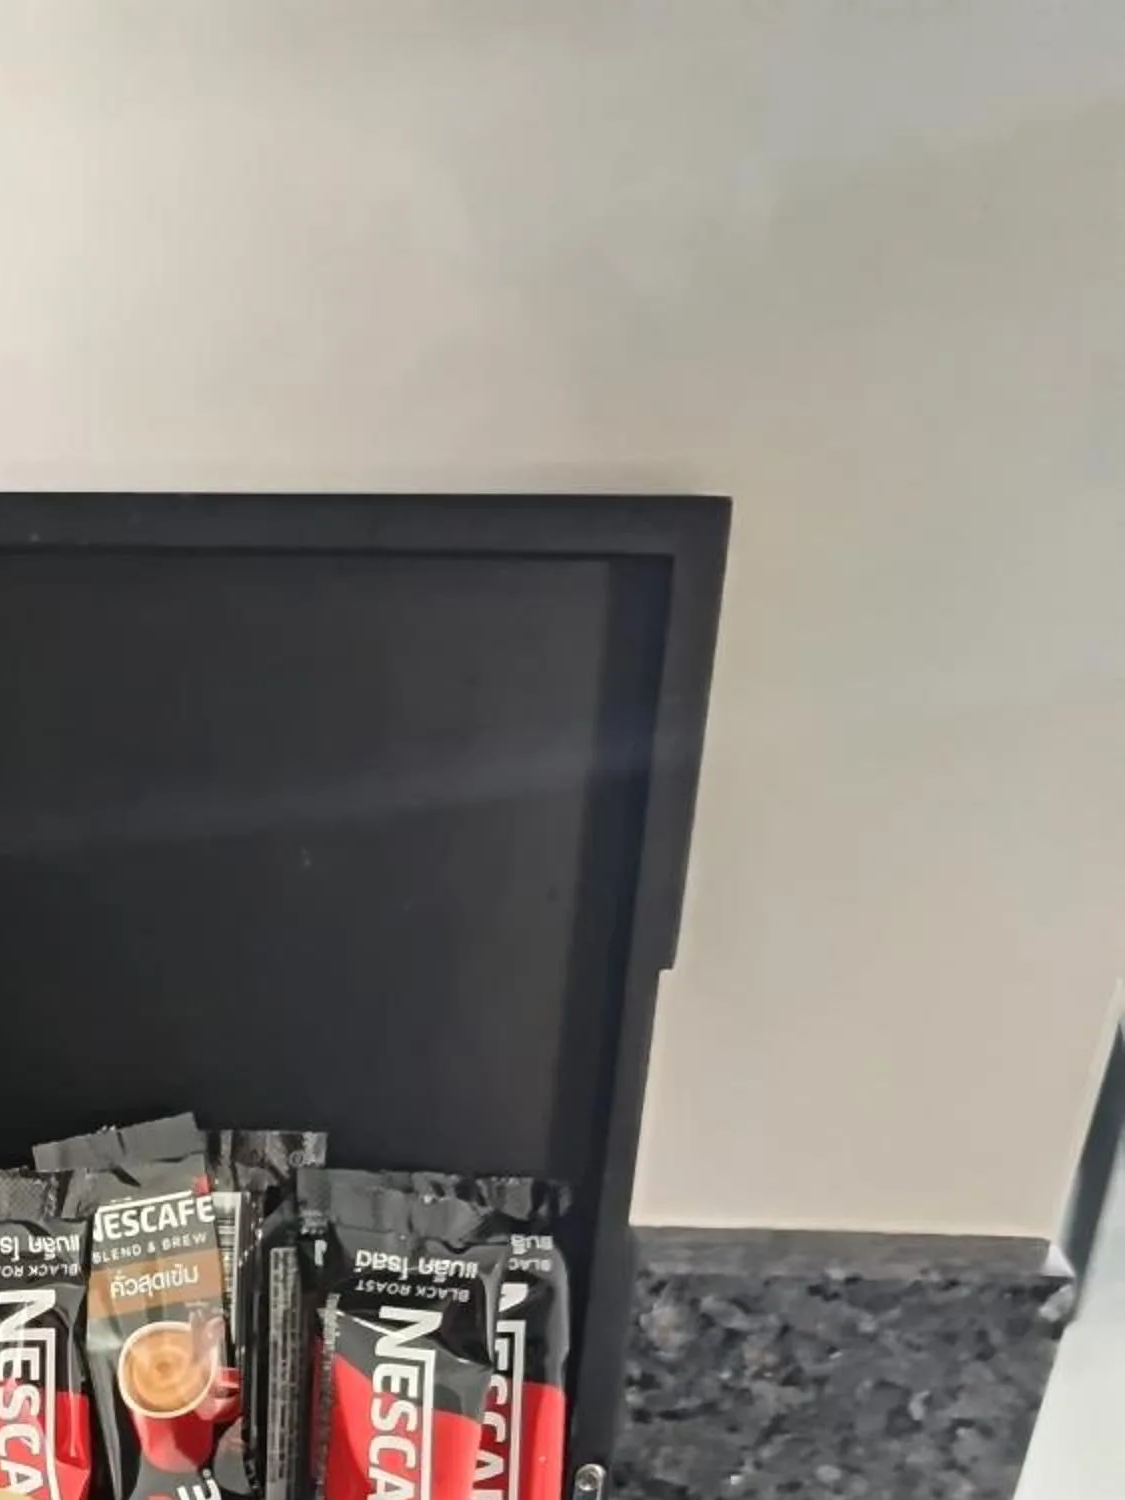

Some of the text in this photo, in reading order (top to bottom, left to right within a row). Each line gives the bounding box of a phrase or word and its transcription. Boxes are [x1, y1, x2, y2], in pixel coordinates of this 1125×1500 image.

[92, 1232, 207, 1264] BLEND & BREW
[28, 1263, 78, 1277] BLACK
[354, 1250, 408, 1280] โรสต์
[110, 1264, 198, 1298] คั่วสุดเข้ม
[355, 1280, 470, 1302] BLACK ROAST
